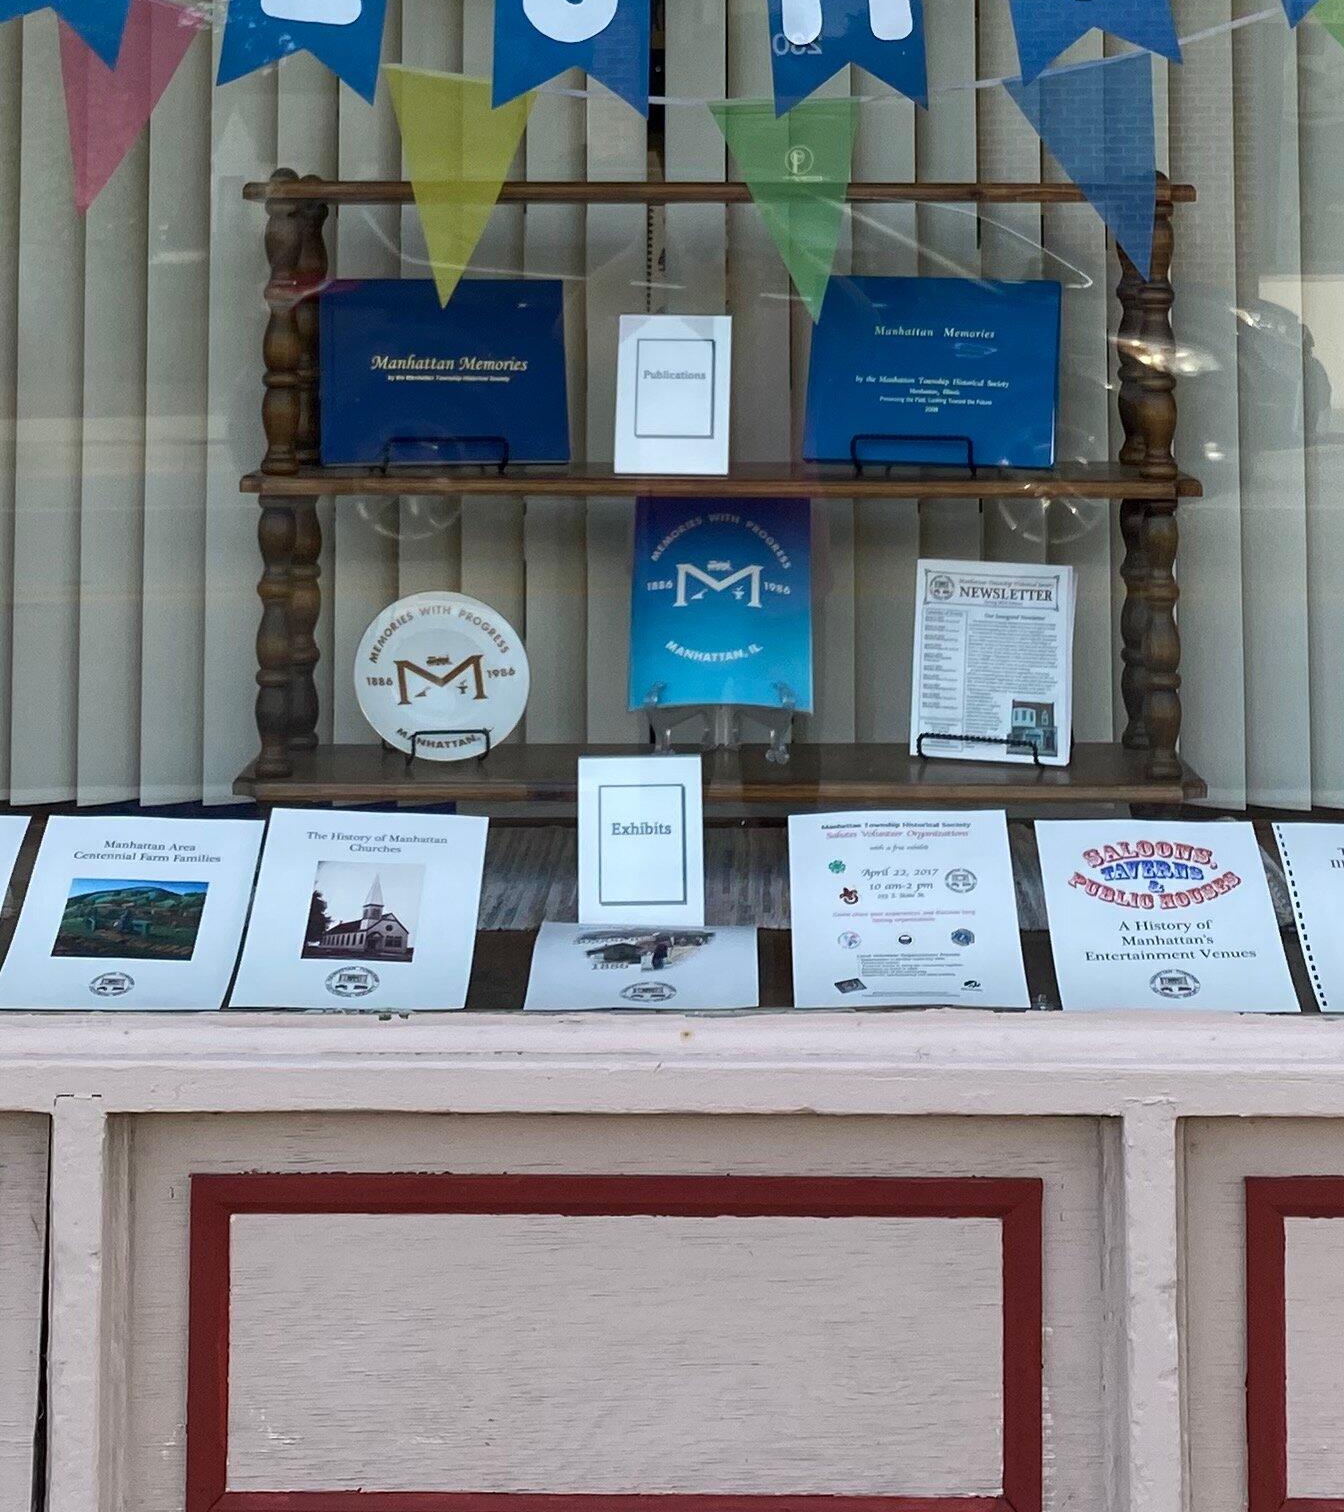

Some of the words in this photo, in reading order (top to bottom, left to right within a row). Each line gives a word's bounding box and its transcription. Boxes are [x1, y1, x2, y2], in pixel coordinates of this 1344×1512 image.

[874, 326, 934, 337] Manhattan
[944, 327, 995, 339] Memories
[370, 354, 454, 371] Manhattan
[459, 356, 528, 372] Memories
[643, 370, 706, 380] Publications
[651, 516, 703, 562] MEMORIES
[709, 513, 740, 524] WITH
[745, 520, 792, 570] PROGRESS
[959, 586, 1053, 601] NEWSLETTER
[368, 611, 414, 664] MEMORIES
[418, 605, 451, 616] WITH
[458, 609, 510, 654] PROGRESS
[487, 667, 516, 678] 1986
[366, 676, 394, 687] 1886
[611, 822, 672, 836] Exhibits
[306, 831, 328, 840] The
[330, 832, 372, 843] History
[374, 834, 388, 842] of
[389, 834, 448, 844] Manhattan
[104, 840, 165, 851] Manhattan
[169, 843, 196, 851] Area
[349, 844, 402, 853] Churches
[73, 851, 136, 861] Centennial
[139, 853, 169, 862] Farm
[173, 853, 221, 863] Families
[1082, 840, 1218, 870] SALOONS,
[861, 867, 891, 880] April
[894, 869, 909, 877] 22,
[914, 868, 939, 876] 2017
[1100, 860, 1204, 881] TAVERNS
[915, 883, 933, 892] pm
[1068, 872, 1155, 910] PUBLIC
[1159, 871, 1242, 910] HOUSES
[1118, 921, 1130, 931] A
[1135, 920, 1192, 933] History
[1196, 919, 1213, 930] of
[1122, 934, 1214, 947] Manhattan's
[1085, 950, 1195, 962] Entertainment
[1199, 948, 1257, 959] Venues
